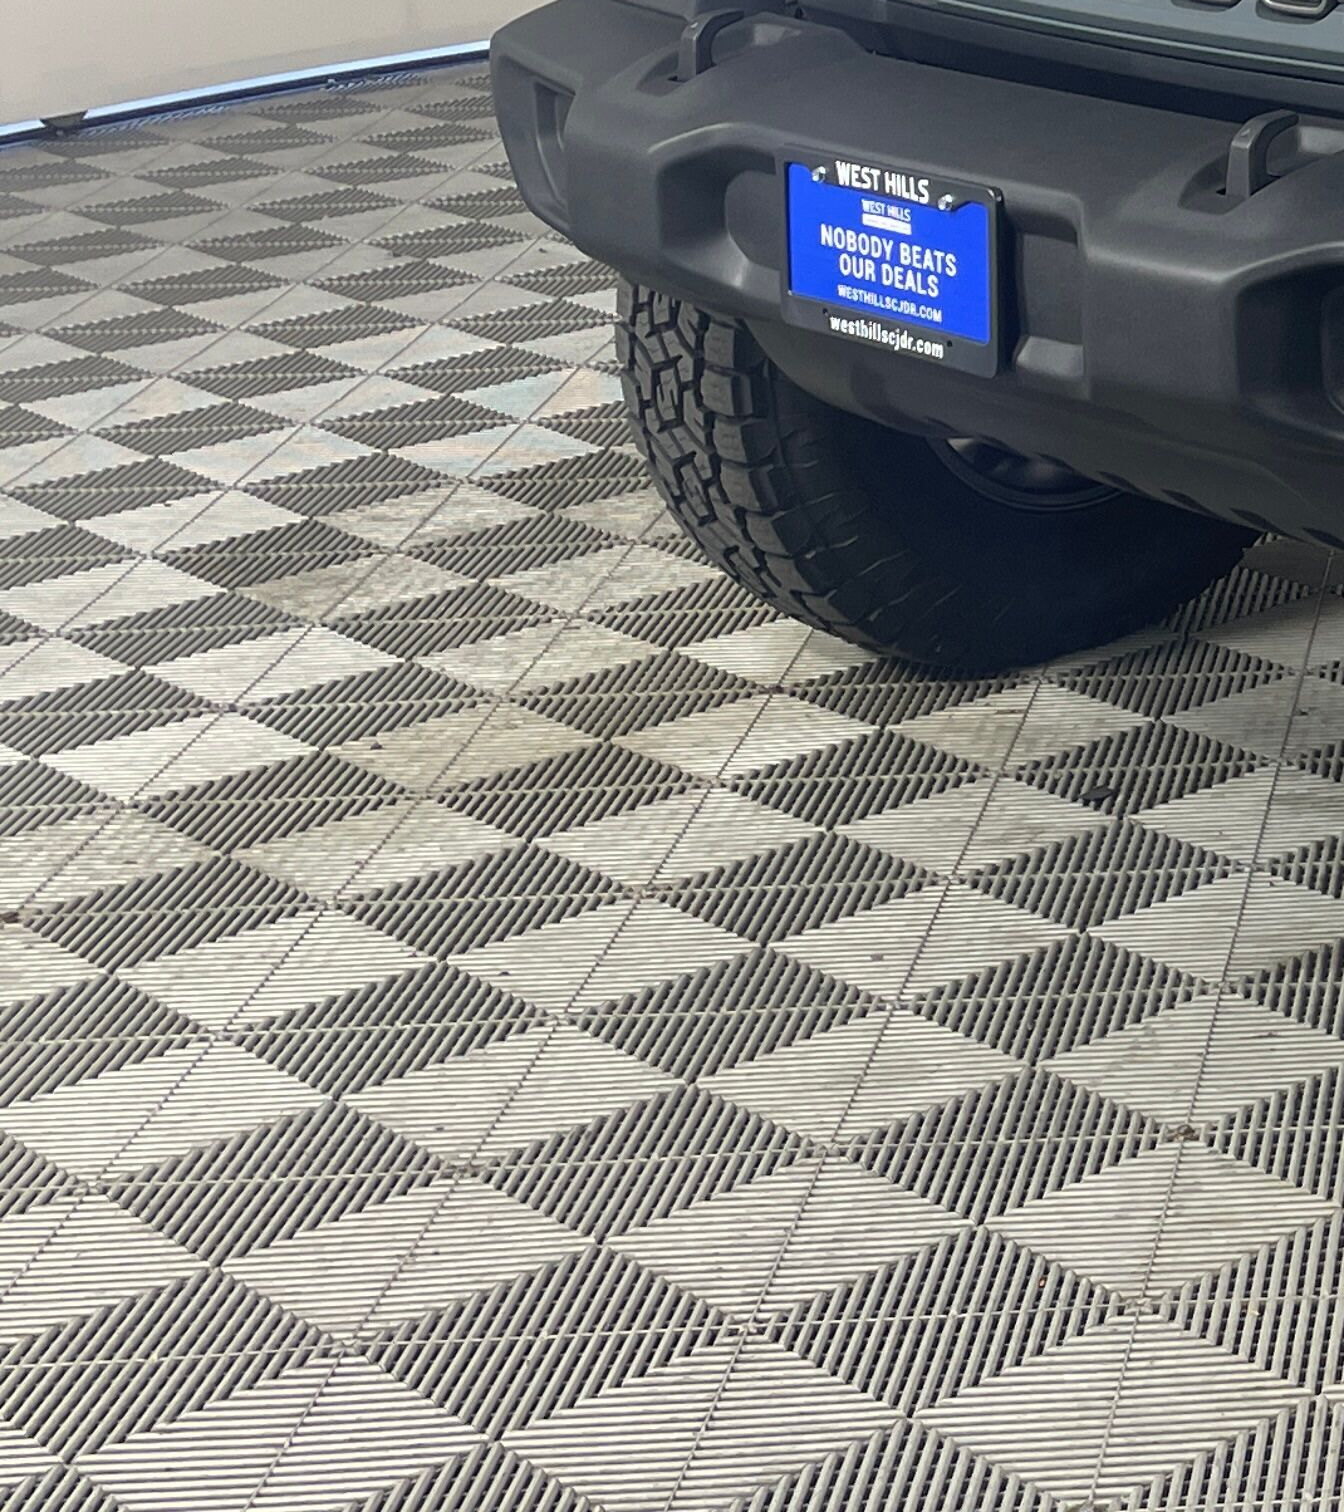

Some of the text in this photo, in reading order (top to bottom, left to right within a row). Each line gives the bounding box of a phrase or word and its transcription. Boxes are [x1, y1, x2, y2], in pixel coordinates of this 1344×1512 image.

[835, 160, 929, 204] WEST HILLS
[861, 199, 911, 221] WEST HILLS
[820, 223, 894, 260] NOBODY
[899, 242, 957, 277] BEATS
[839, 253, 939, 298] OUR DEALS
[837, 284, 942, 323] WESTHILLSCJDR.COM
[829, 315, 944, 359] westhillscjdr.com
